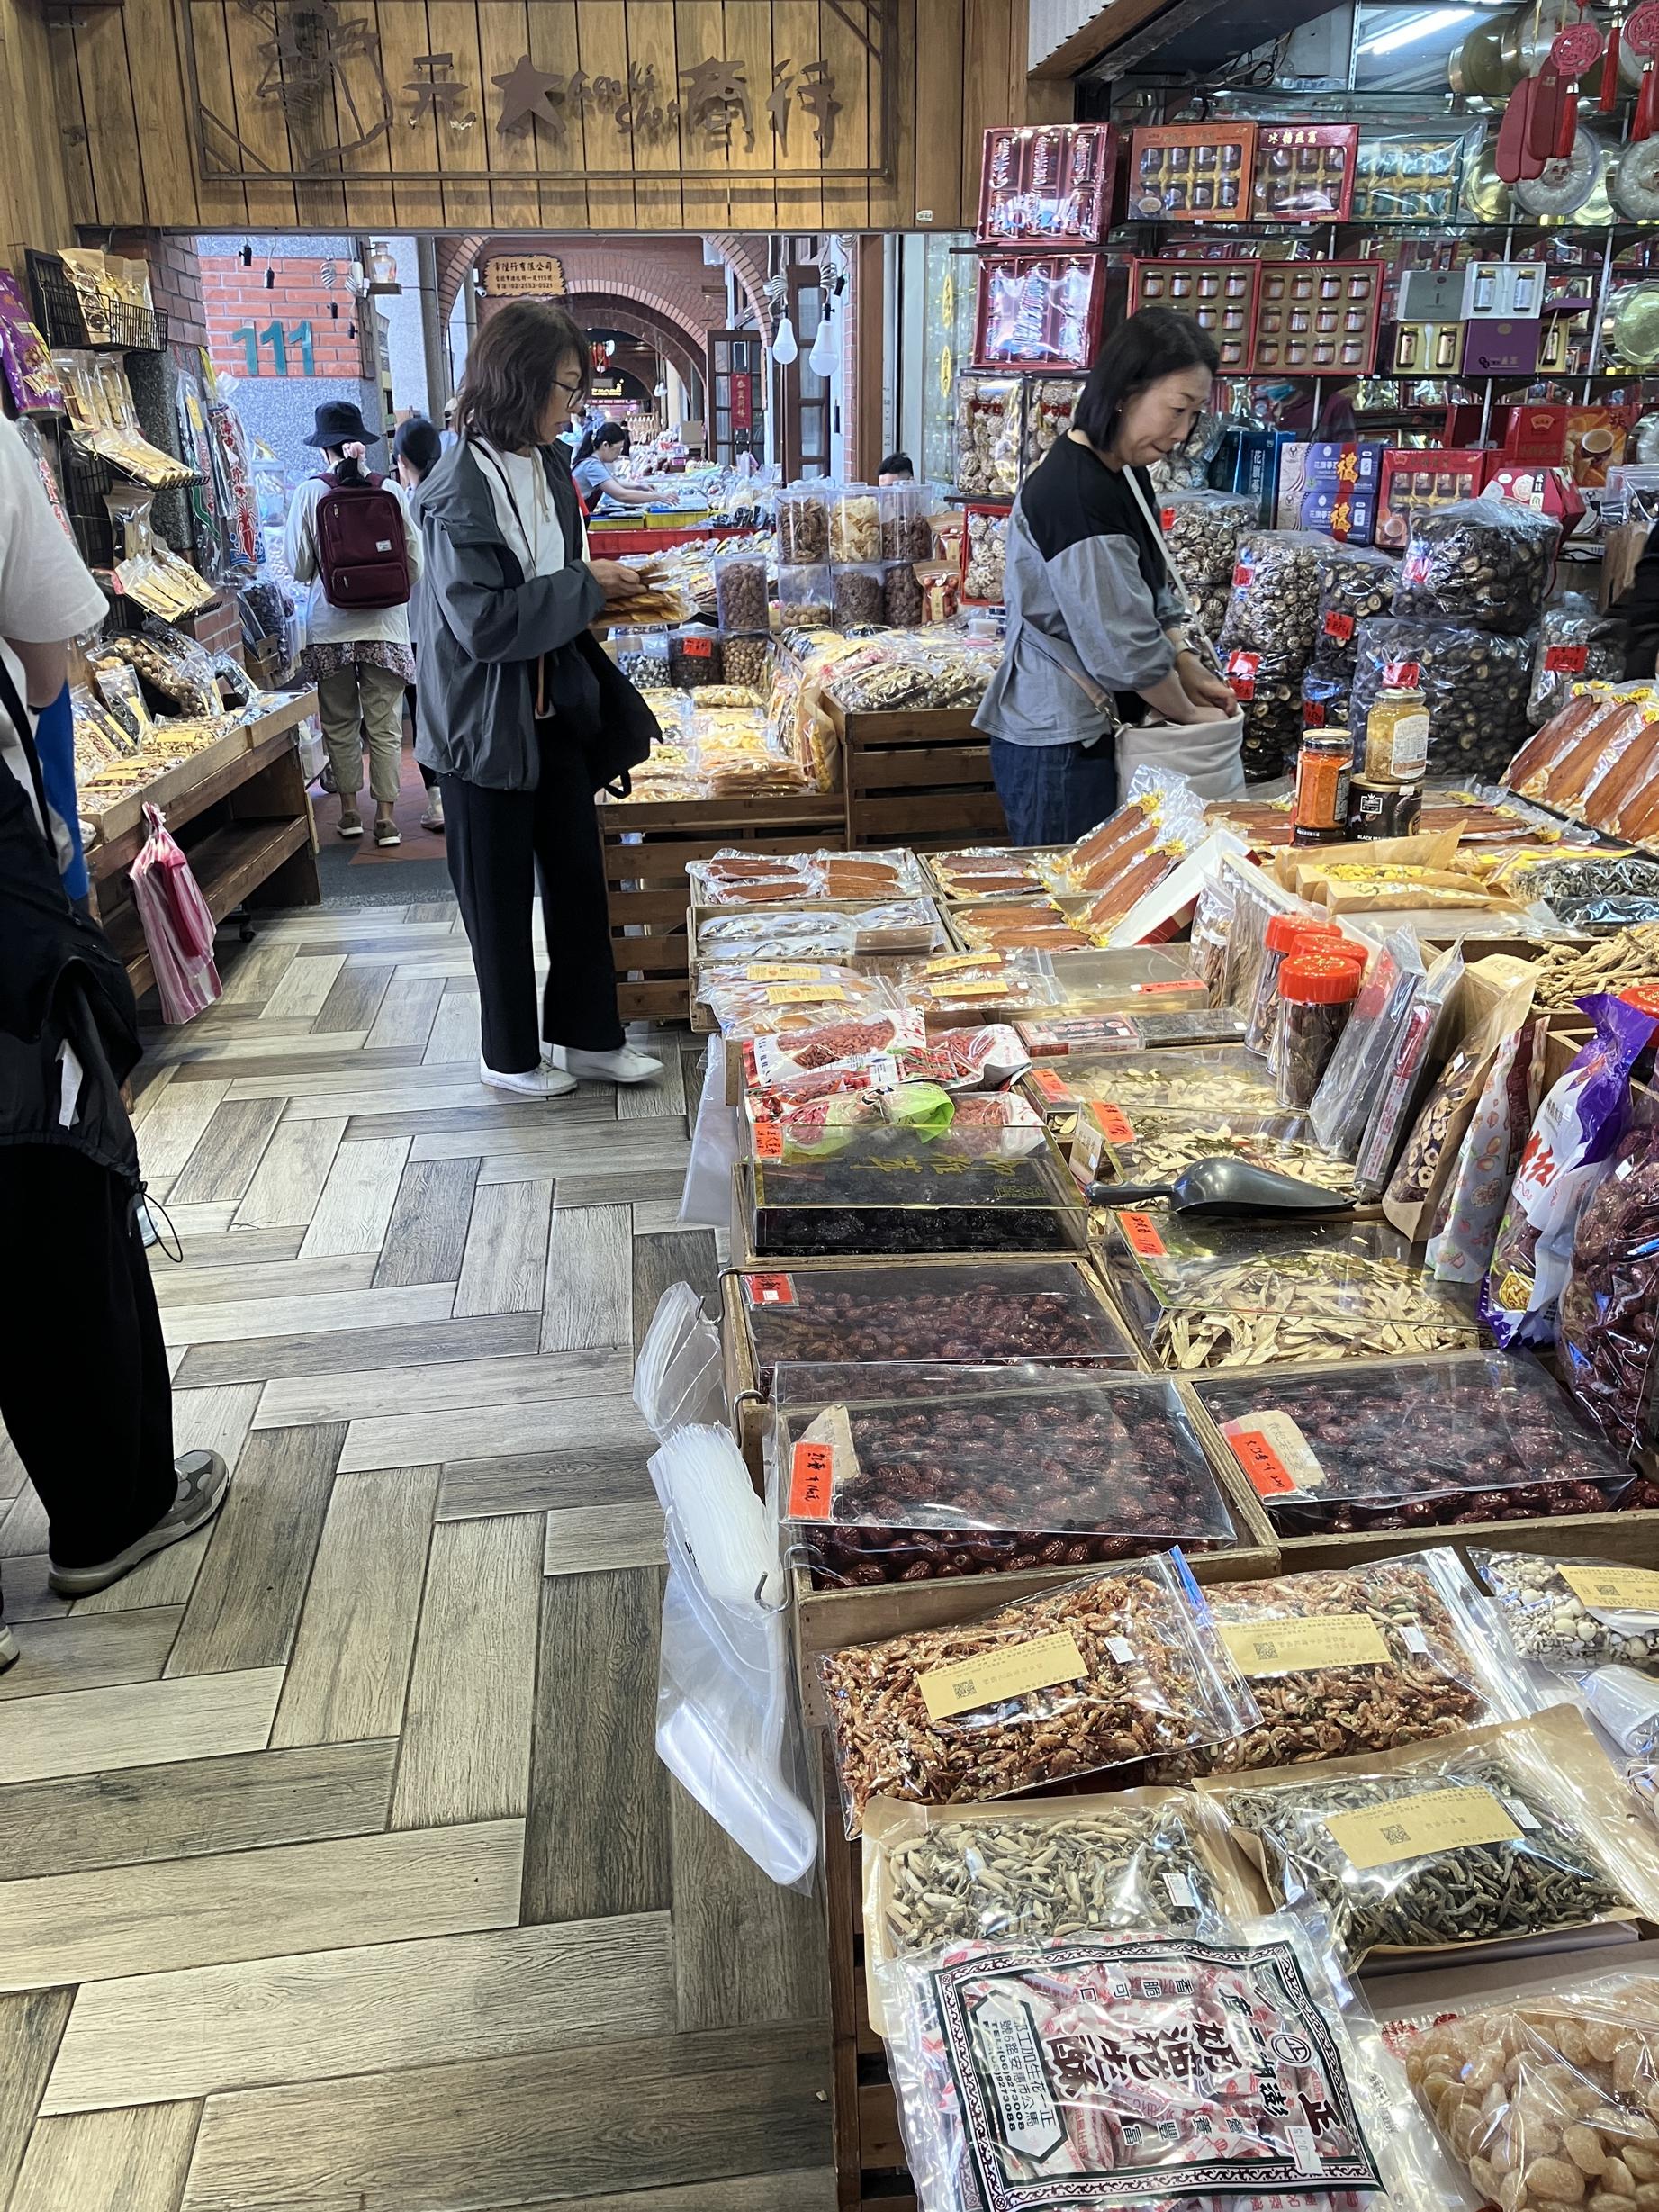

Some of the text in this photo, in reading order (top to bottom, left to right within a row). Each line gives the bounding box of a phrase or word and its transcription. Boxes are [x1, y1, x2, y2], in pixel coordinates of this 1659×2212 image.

[402, 52, 837, 149] 元 商行
[231, 320, 315, 375] 111
[1079, 1978, 1195, 2004] 香脆可口
[1047, 2020, 1243, 2099] 奶油花生酥
[1123, 2117, 1247, 2145] 營養豐富
